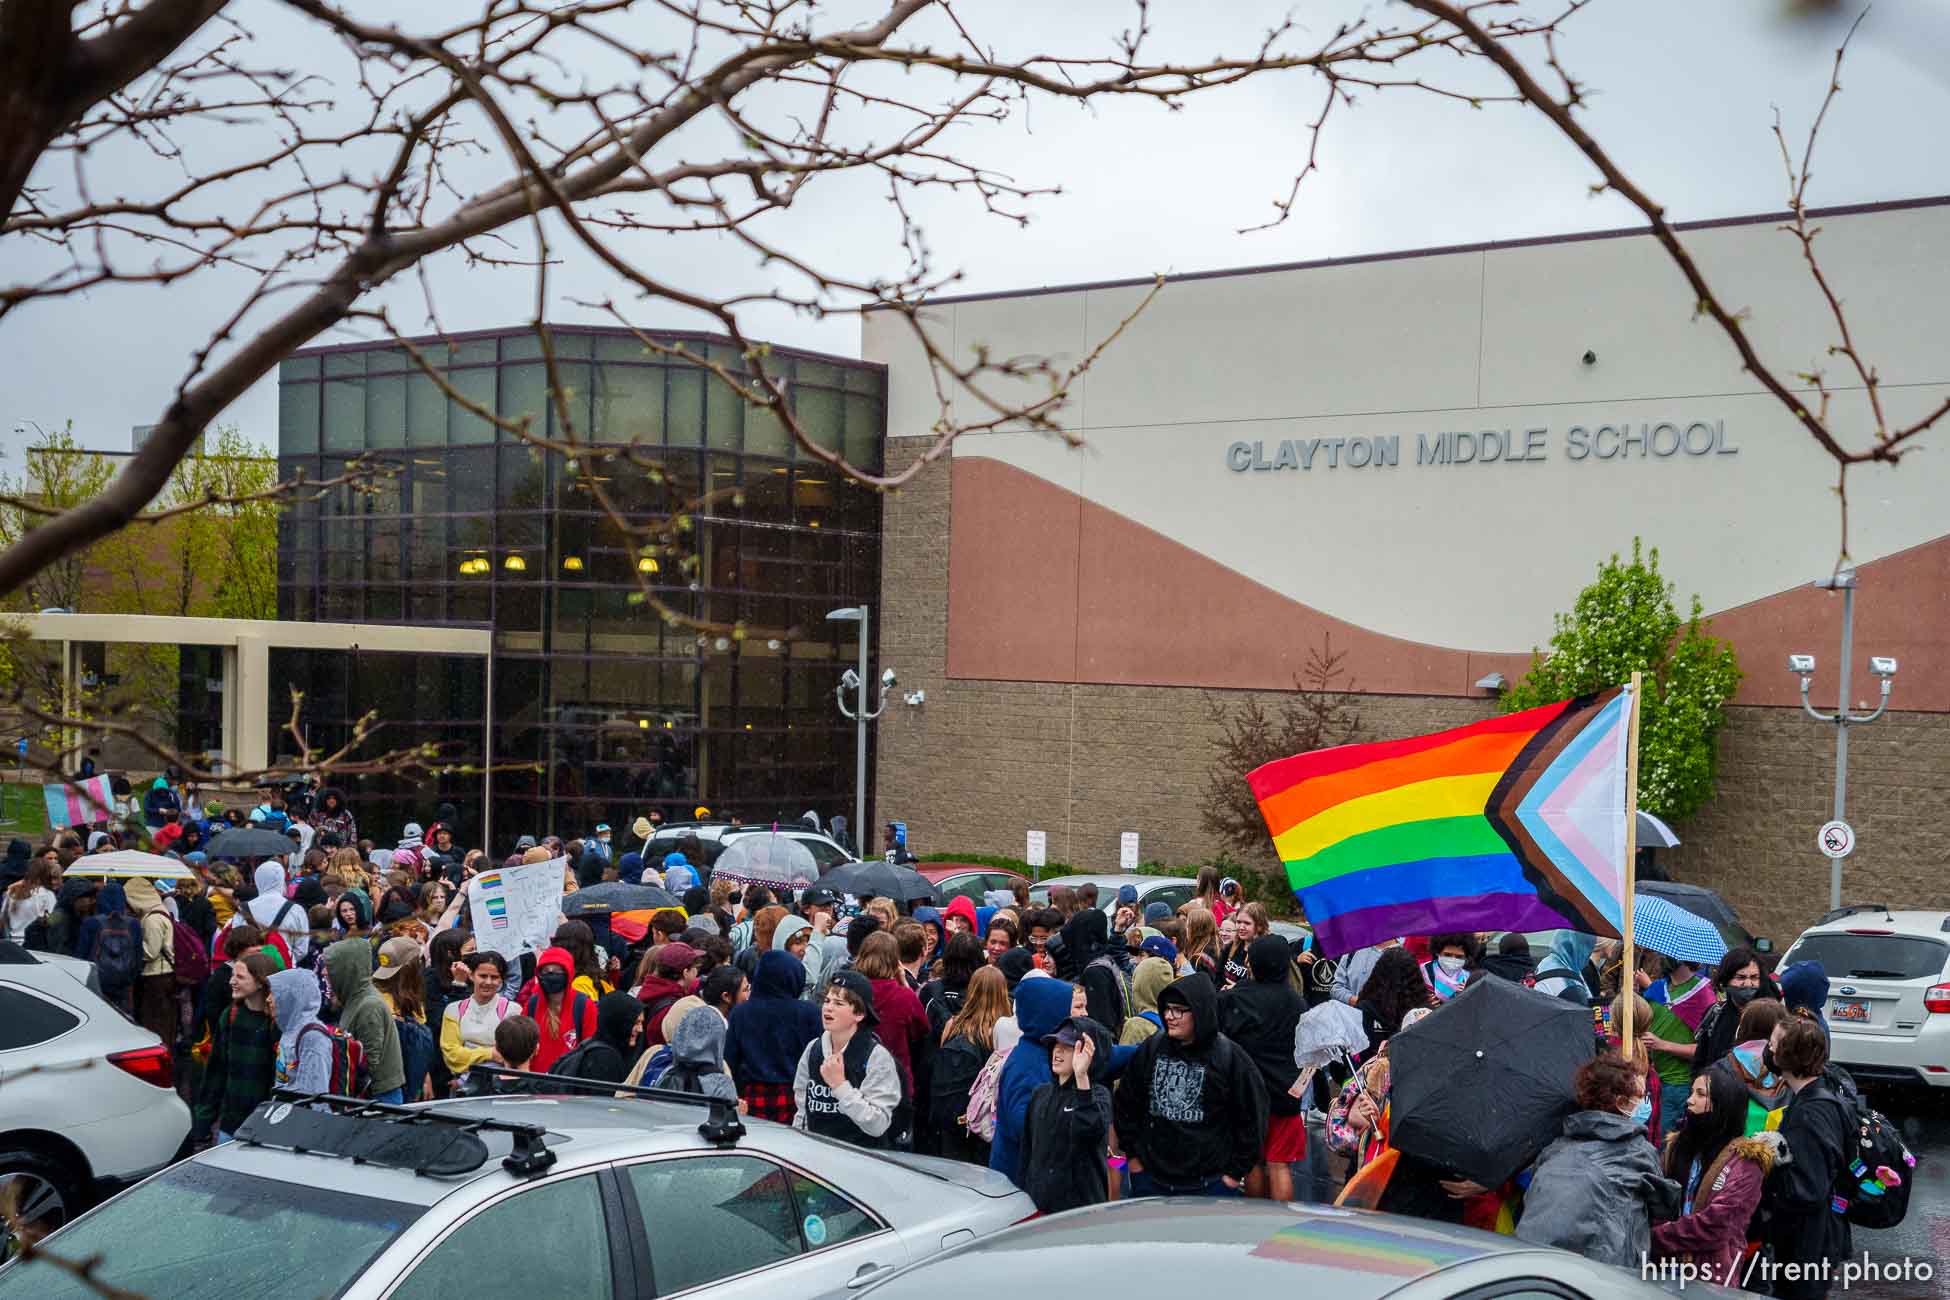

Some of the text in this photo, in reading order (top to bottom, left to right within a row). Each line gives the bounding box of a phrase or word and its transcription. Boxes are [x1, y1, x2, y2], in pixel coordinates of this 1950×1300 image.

[1226, 418, 1738, 472] CLAYTON MIDDLE SCHOOL
[808, 1080, 834, 1099] ROU
